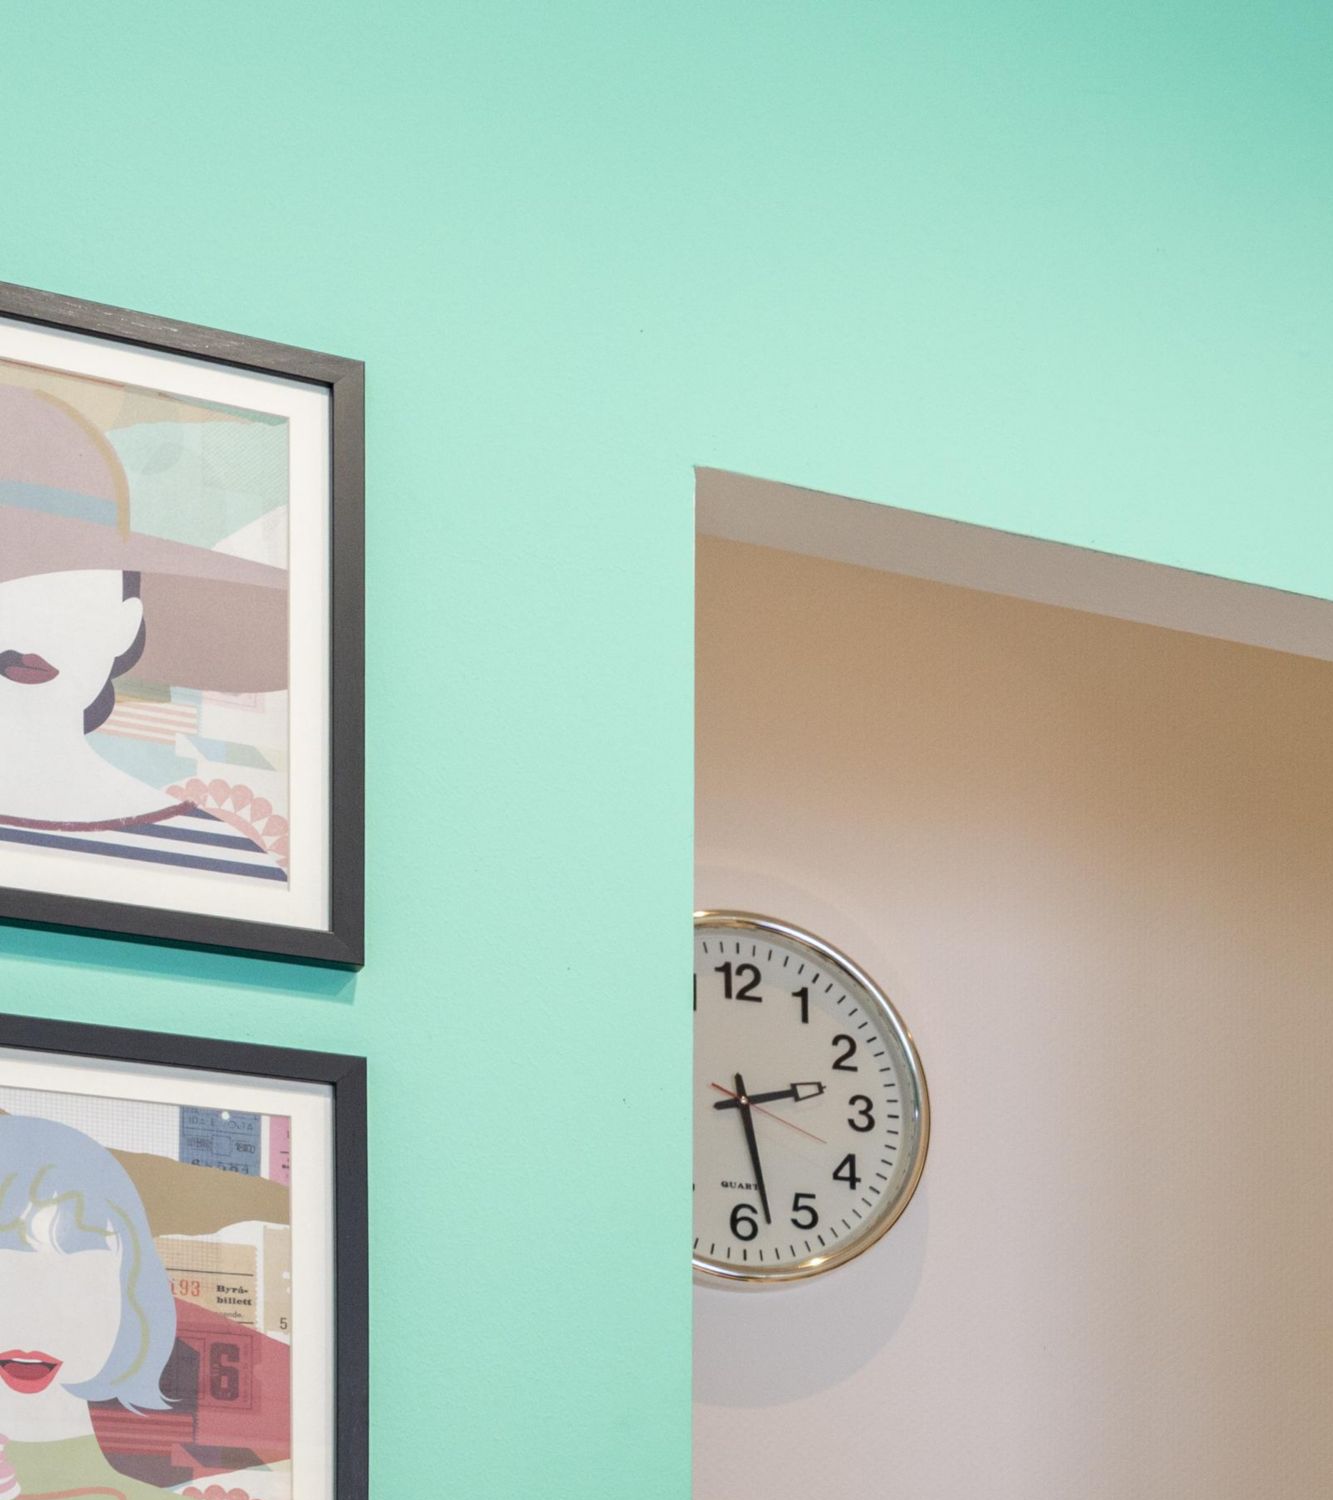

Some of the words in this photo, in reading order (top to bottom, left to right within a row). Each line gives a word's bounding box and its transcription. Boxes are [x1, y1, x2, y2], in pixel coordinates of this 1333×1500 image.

[714, 961, 763, 1003] 12
[791, 986, 809, 1024] 1
[831, 1034, 858, 1072] 2
[847, 1094, 876, 1133] 3
[721, 1180, 759, 1191] QUART
[832, 1153, 862, 1191] 4
[729, 1202, 759, 1242] 6
[790, 1192, 819, 1230] 5
[216, 1296, 252, 1306] billett
[280, 1317, 288, 1330] 5
[209, 1341, 241, 1402] 6
